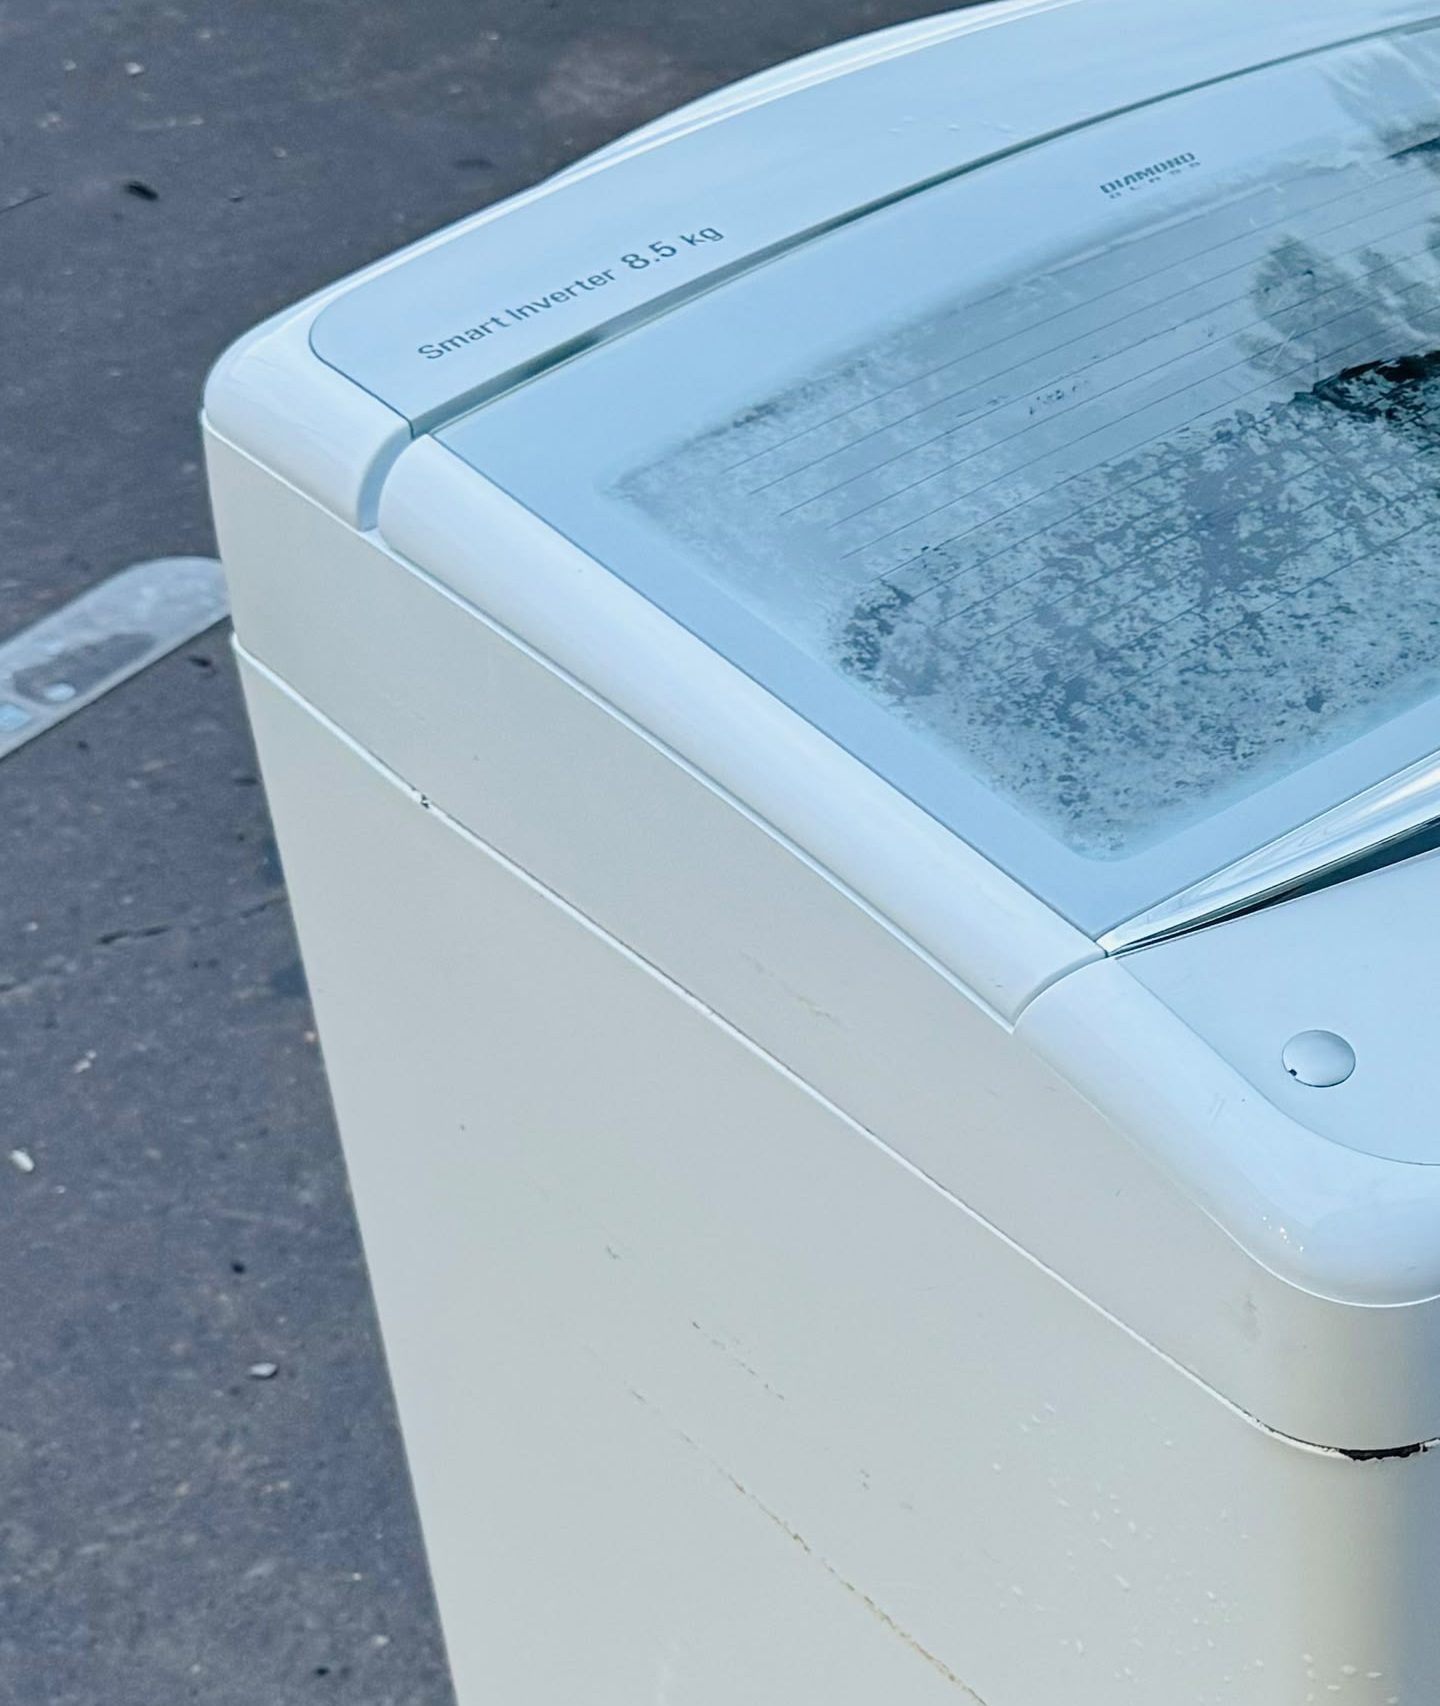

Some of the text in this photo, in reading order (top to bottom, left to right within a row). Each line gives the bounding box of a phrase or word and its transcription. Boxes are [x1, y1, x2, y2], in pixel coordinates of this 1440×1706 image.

[418, 226, 725, 360] Smart Inverter 8.5 kg
